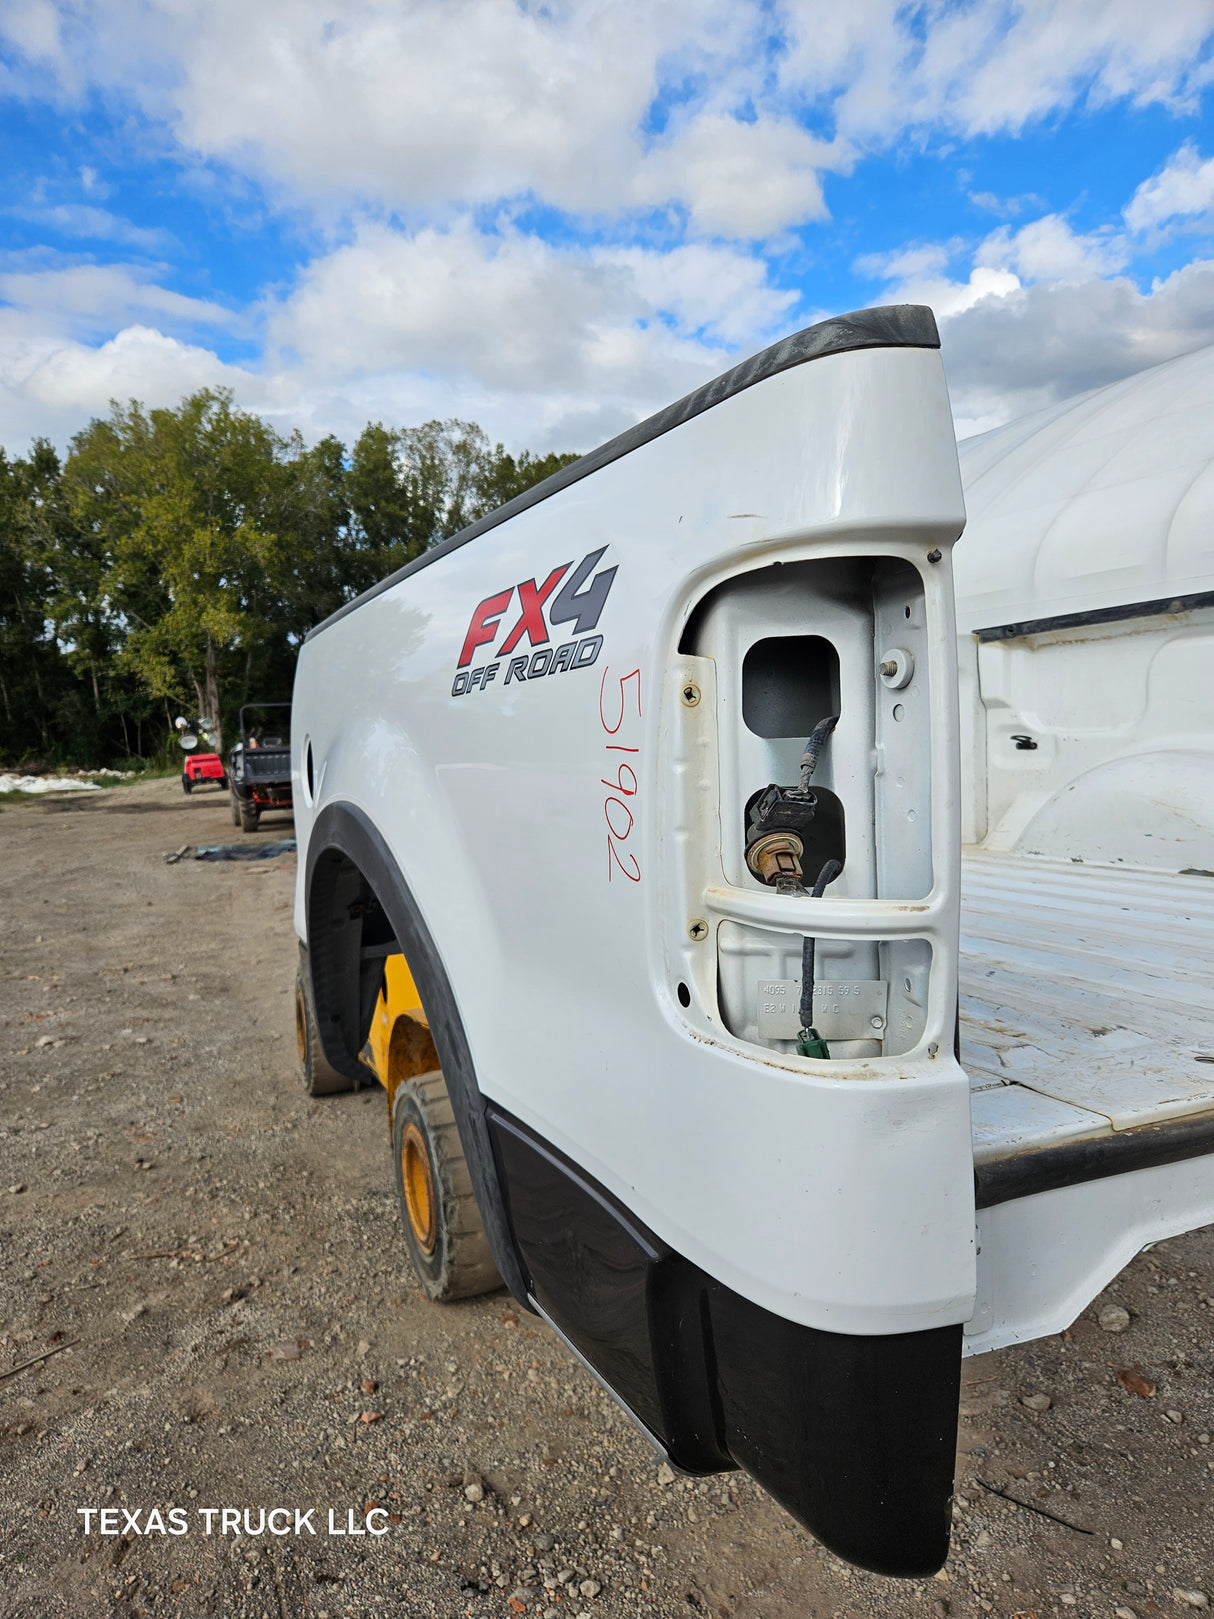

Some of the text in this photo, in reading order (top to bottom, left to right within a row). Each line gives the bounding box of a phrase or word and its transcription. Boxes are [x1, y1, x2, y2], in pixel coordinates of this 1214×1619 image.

[451, 634, 605, 697] OFF ROAD
[456, 543, 620, 670] FX4
[599, 665, 642, 883] 51902
